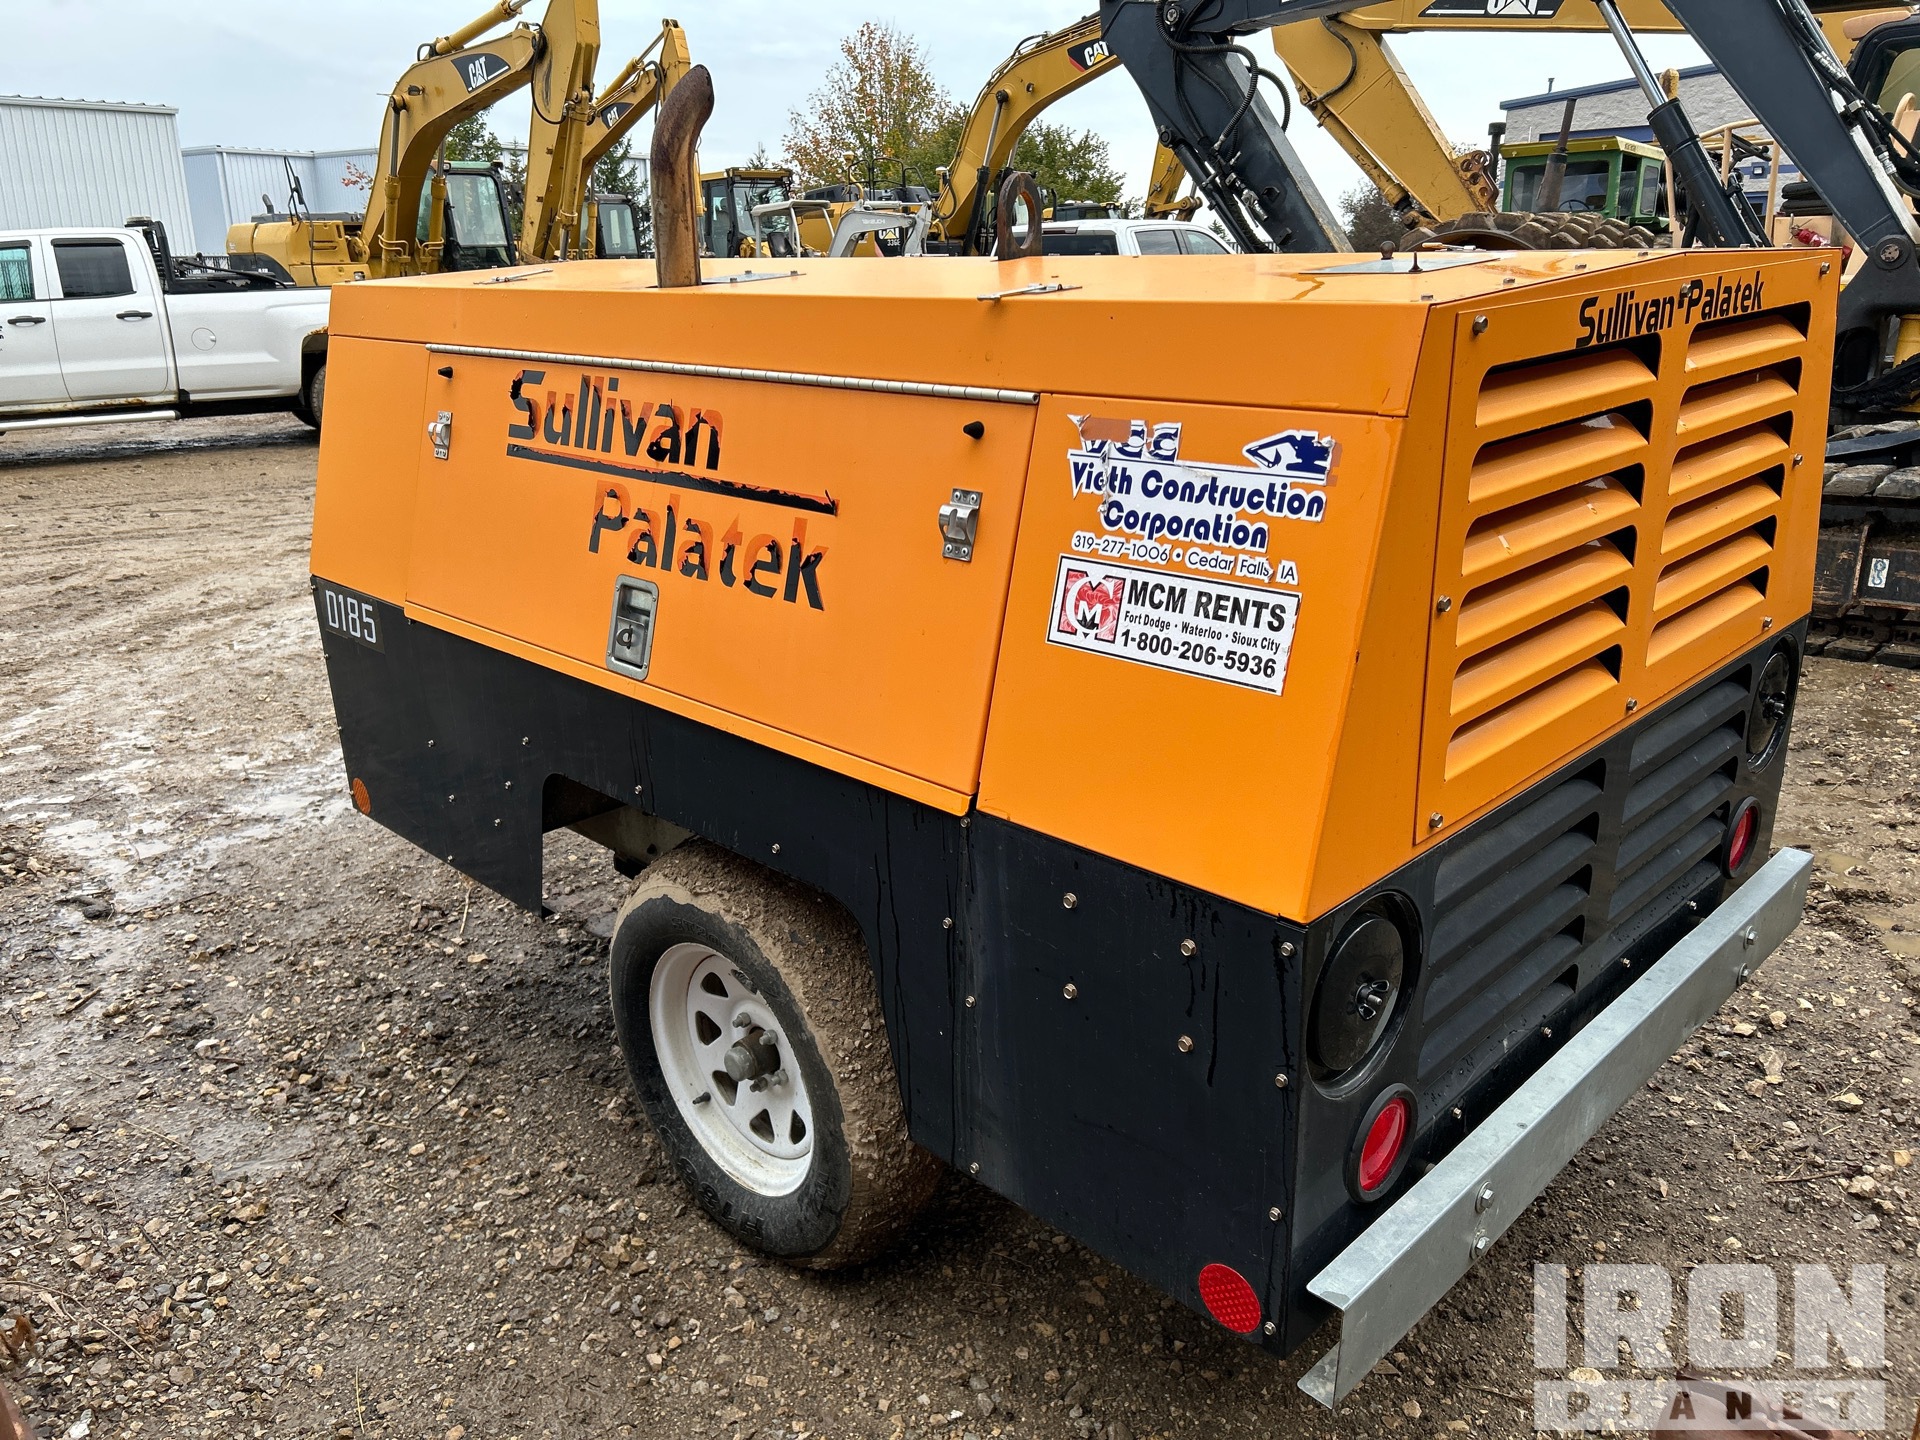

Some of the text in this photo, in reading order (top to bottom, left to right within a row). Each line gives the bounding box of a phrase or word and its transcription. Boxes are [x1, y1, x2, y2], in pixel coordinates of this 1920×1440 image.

[468, 56, 488, 88] CAT
[1084, 40, 1109, 66] CAT
[607, 106, 619, 127] CAT
[507, 369, 724, 471] Sullivan
[1141, 470, 1324, 518] Construction
[588, 479, 830, 612] Palatek
[1104, 499, 1267, 549] Corporation
[1074, 535, 1168, 561] 319-277-1006
[1188, 552, 1234, 570] Cedar
[1280, 564, 1295, 581] IA
[1127, 579, 1286, 632] MCM RENTS
[1121, 629, 1277, 678] 1-800-206-5936
[1124, 610, 1281, 655] Fort Dodge Waterloo Sioux City
